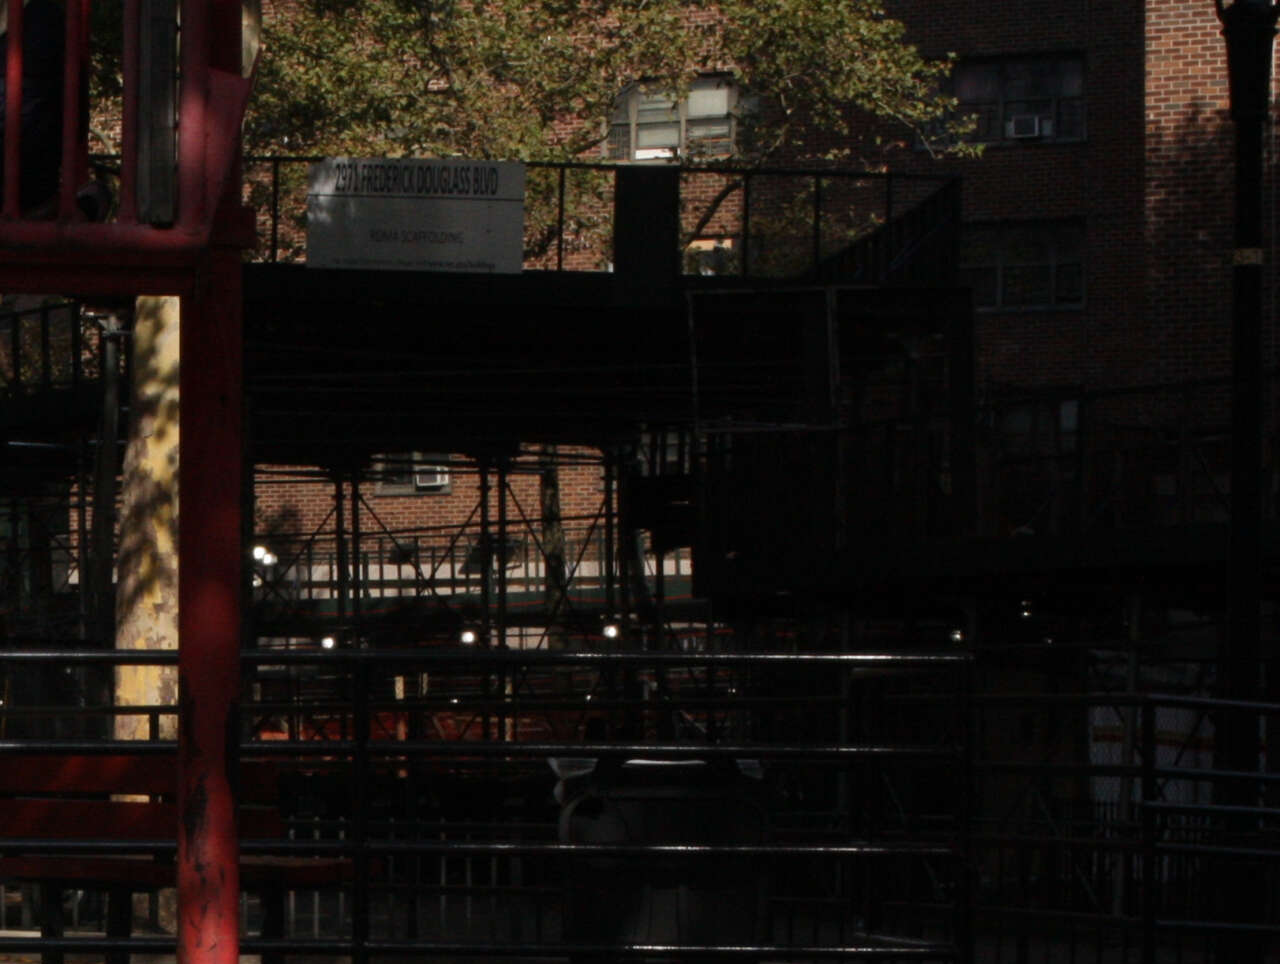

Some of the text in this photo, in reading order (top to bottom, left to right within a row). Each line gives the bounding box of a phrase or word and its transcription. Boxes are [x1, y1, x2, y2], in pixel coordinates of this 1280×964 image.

[361, 164, 414, 193] FREDERICK
[417, 165, 470, 195] DOUGLASS
[472, 167, 498, 195] BLVD
